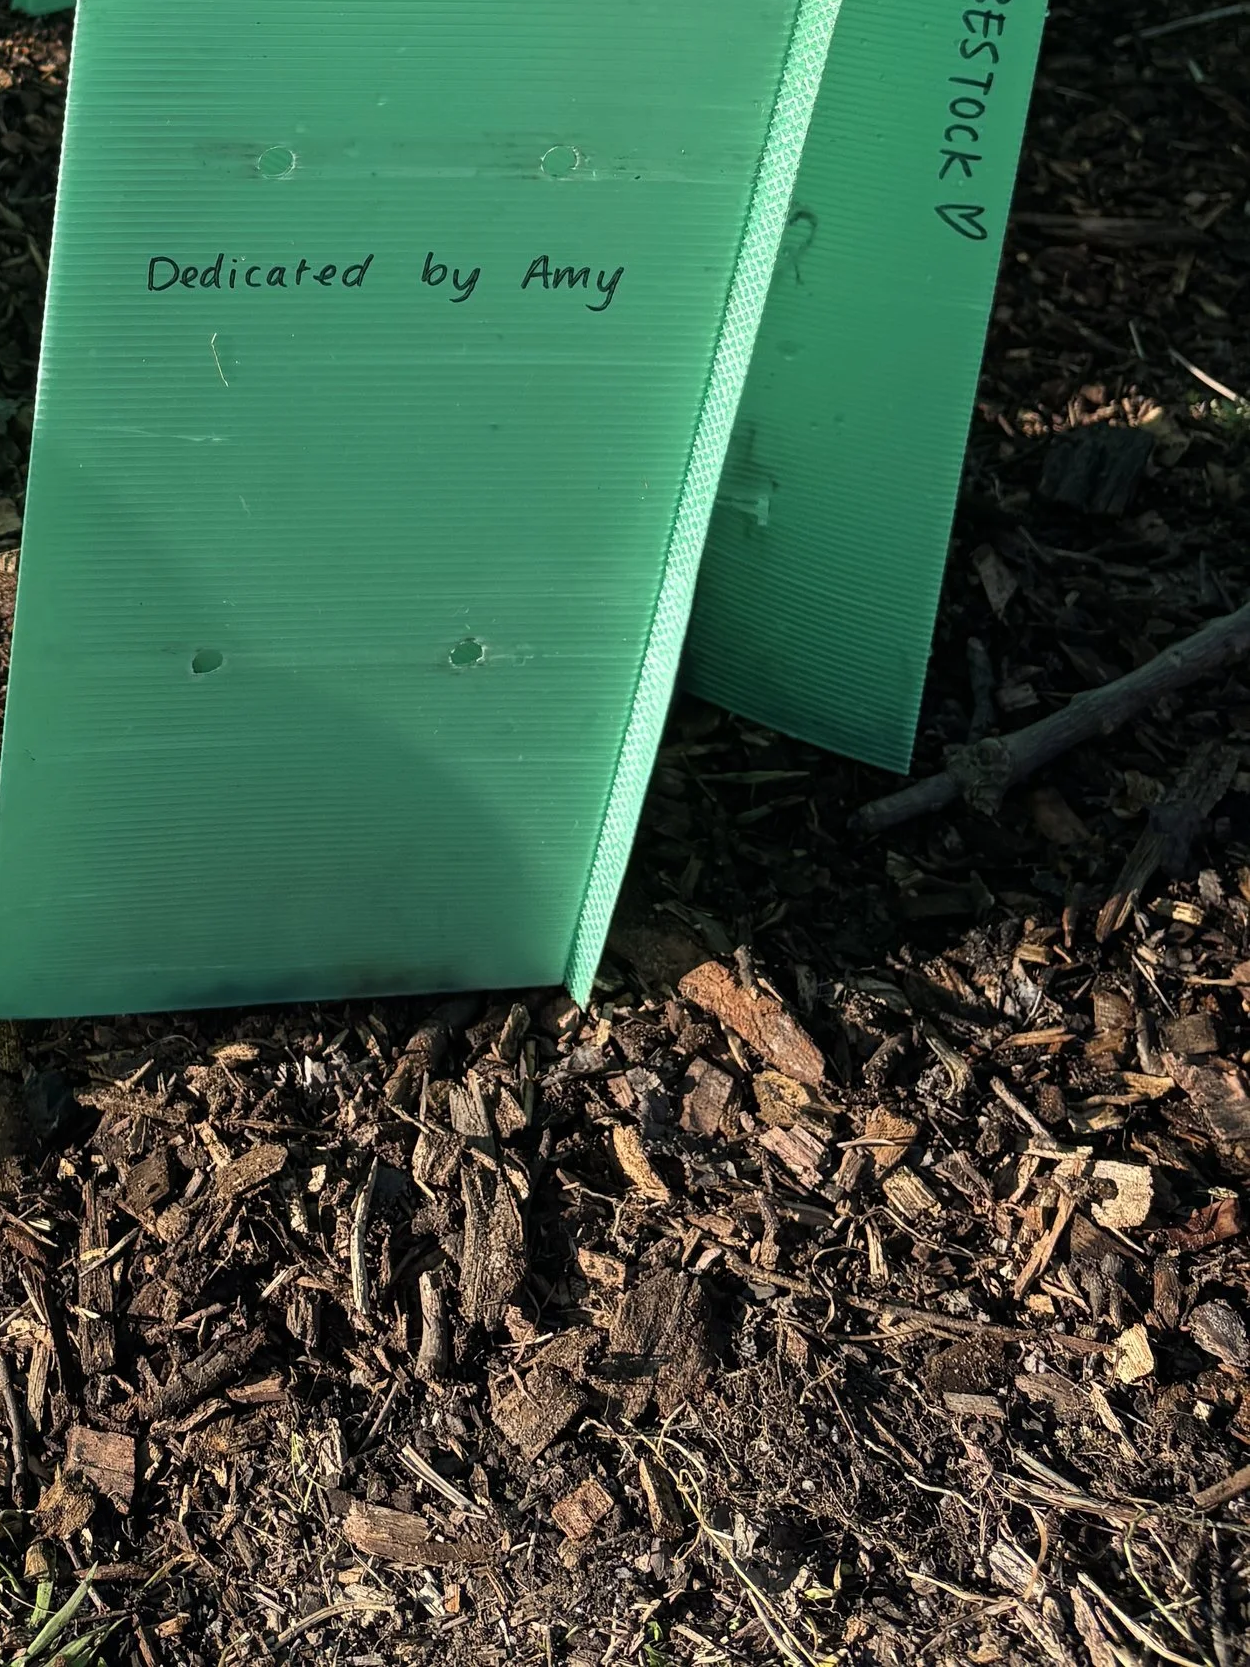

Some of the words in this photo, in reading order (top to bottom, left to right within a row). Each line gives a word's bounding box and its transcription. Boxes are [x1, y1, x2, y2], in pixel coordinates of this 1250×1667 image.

[148, 254, 374, 291] Dedicated
[421, 252, 481, 304] by
[520, 254, 625, 312] Amy
